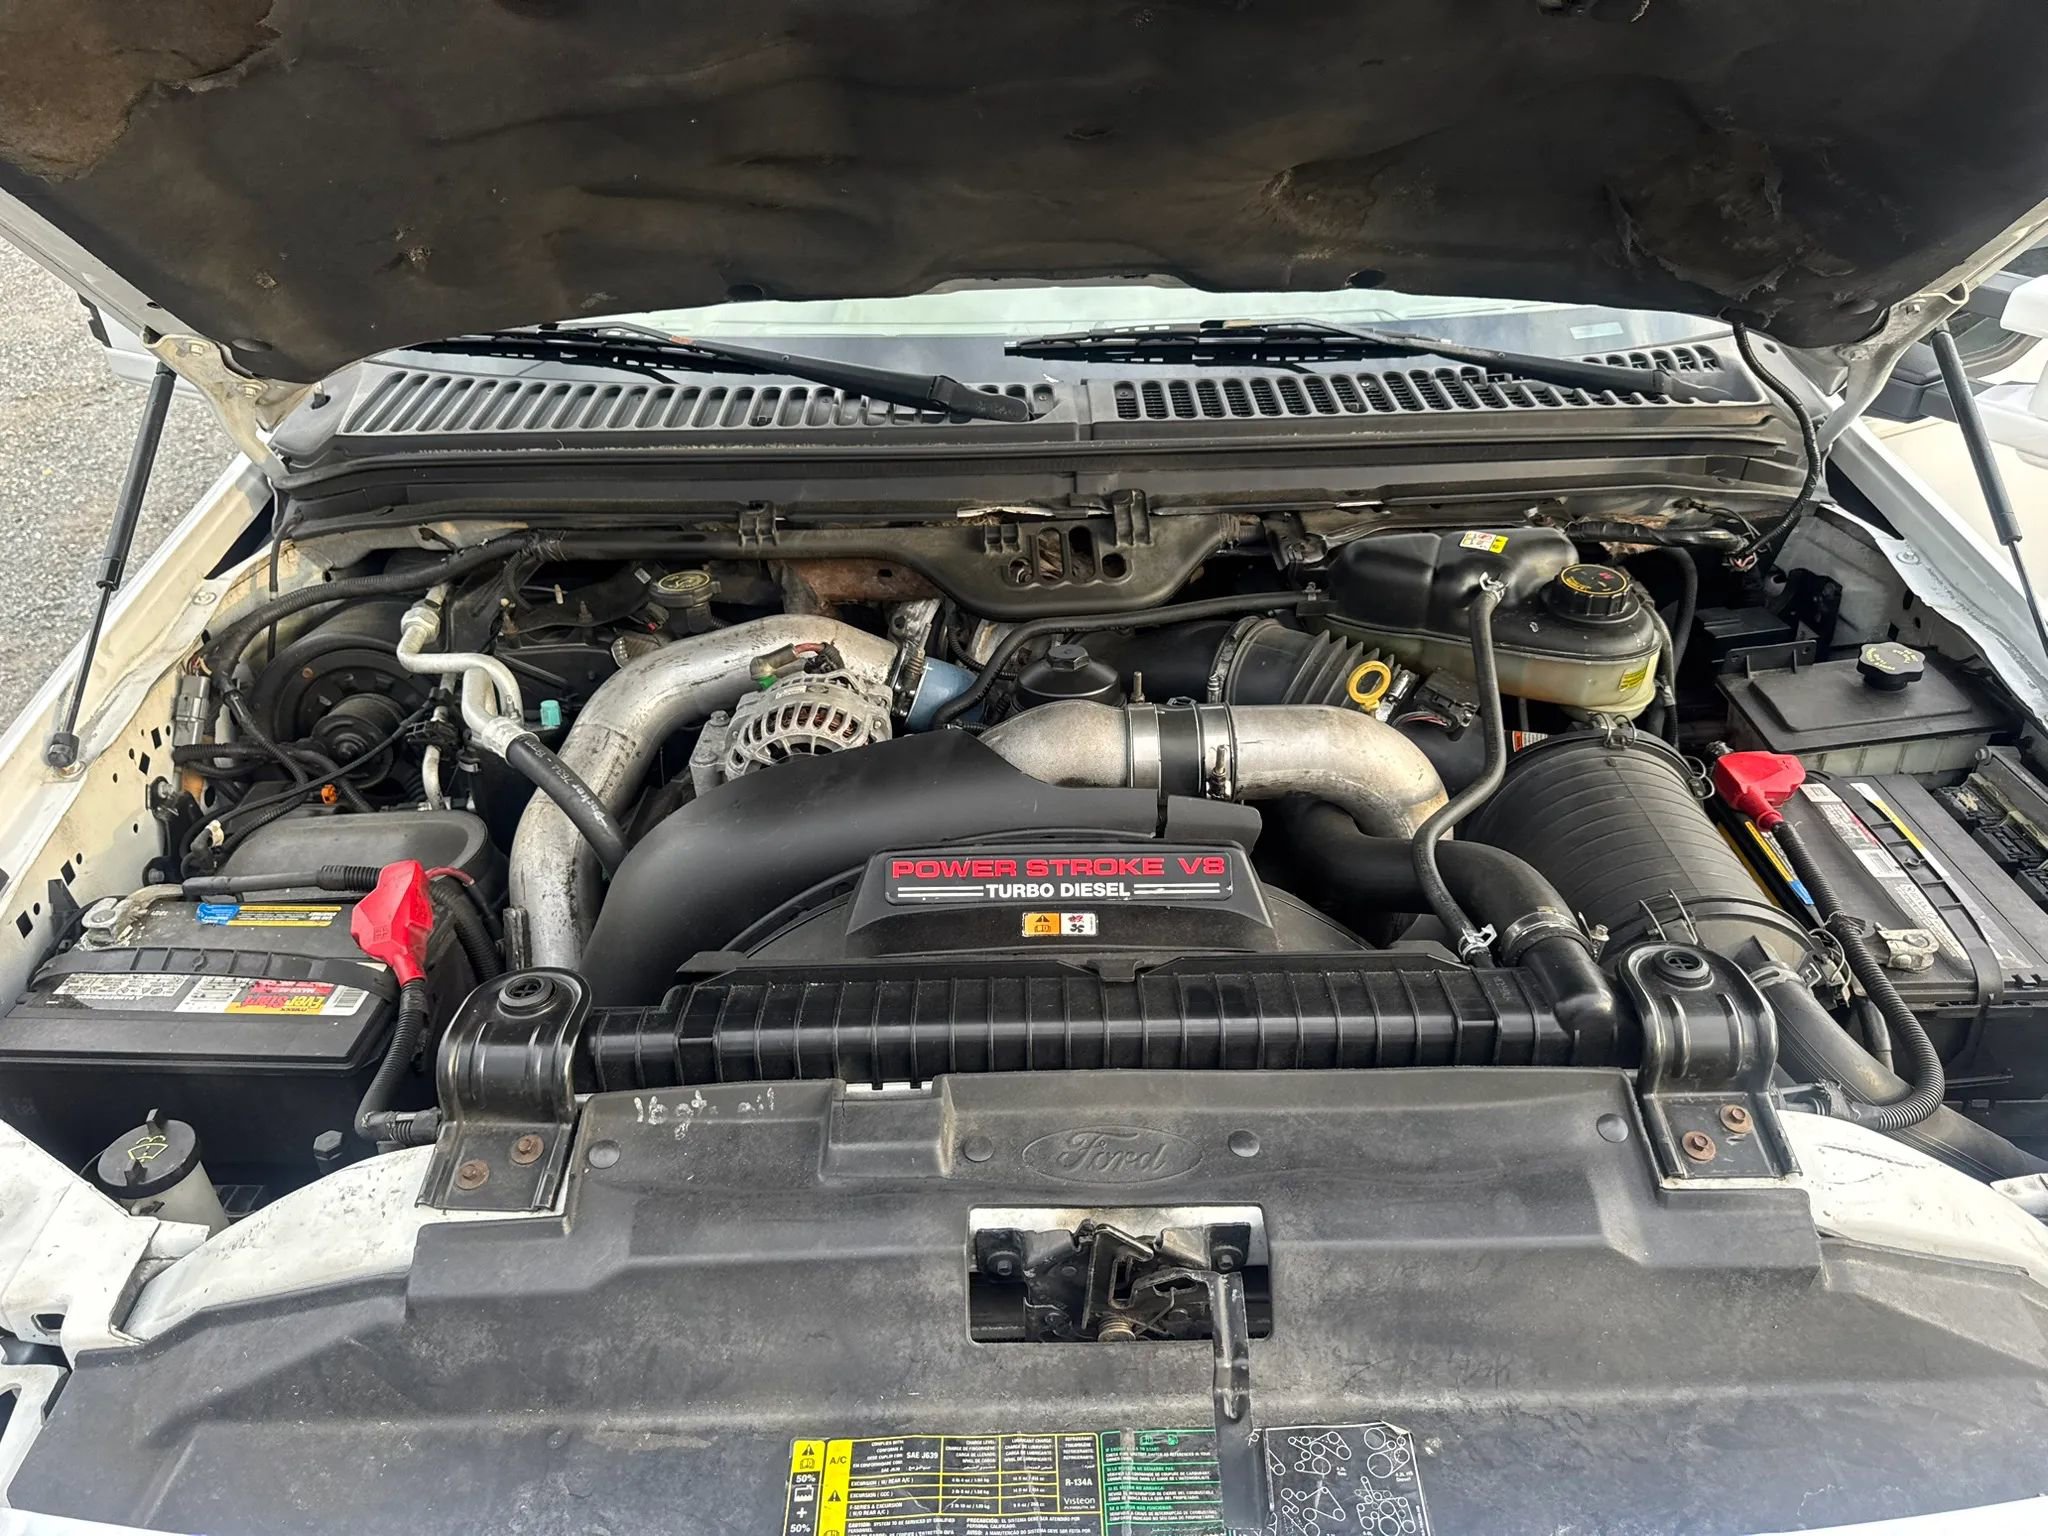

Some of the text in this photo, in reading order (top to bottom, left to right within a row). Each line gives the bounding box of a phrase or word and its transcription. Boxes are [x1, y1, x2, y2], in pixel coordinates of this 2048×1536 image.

[892, 856, 1225, 879] POWER STROKE V8
[986, 882, 1131, 899] TURBO DIESEL
[1056, 1131, 1168, 1173] Ford
[830, 1456, 847, 1464] A/C
[796, 1474, 816, 1483] 50%
[1065, 1478, 1093, 1486] R-134A
[790, 1523, 811, 1533] 50%
